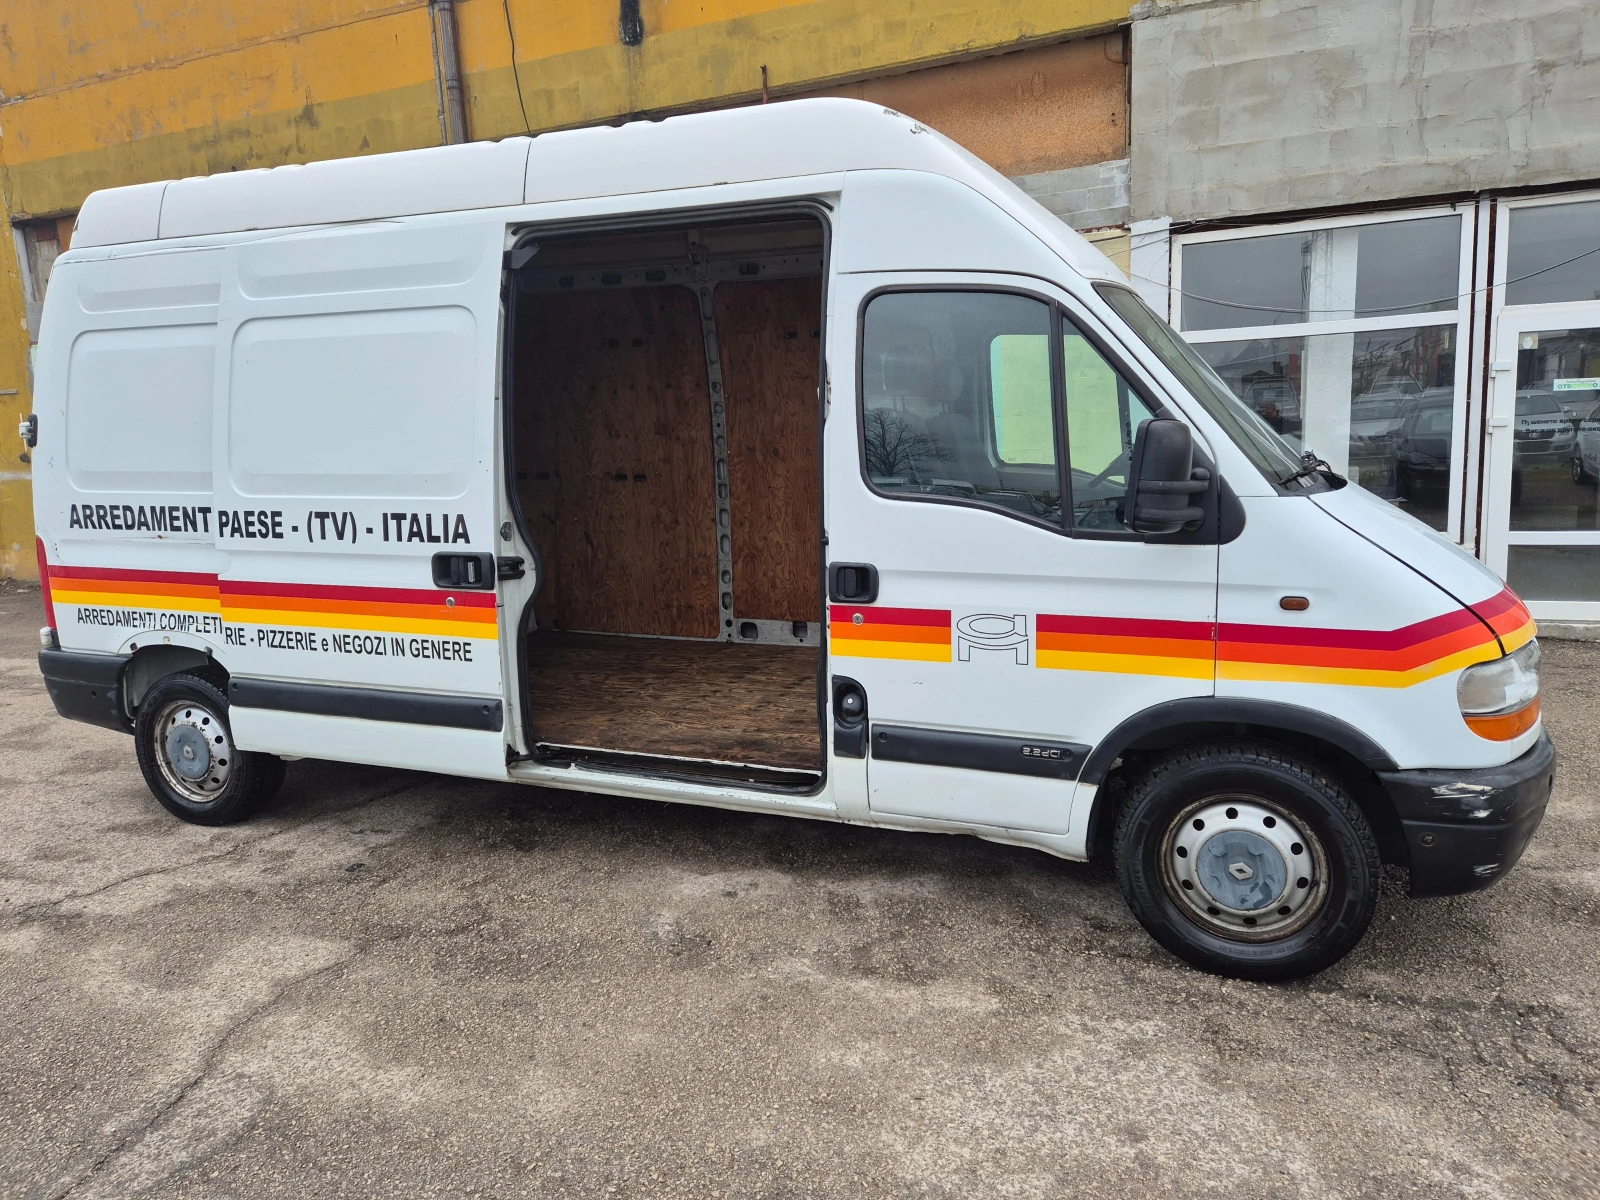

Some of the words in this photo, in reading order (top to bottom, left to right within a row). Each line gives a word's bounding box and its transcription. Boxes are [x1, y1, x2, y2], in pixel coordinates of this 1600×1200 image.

[69, 503, 212, 533] ARREDAMENT
[217, 510, 284, 539] PAESE
[306, 511, 357, 544] (TV)
[382, 512, 471, 544] ITALIA
[77, 607, 156, 630] ARREDAMENTI
[159, 612, 223, 635] COMPLETI
[257, 629, 318, 652] PIZZERIE
[321, 638, 329, 652] e
[332, 634, 387, 656] NEGOZI
[390, 637, 405, 657] IN
[409, 638, 473, 663] GENERE
